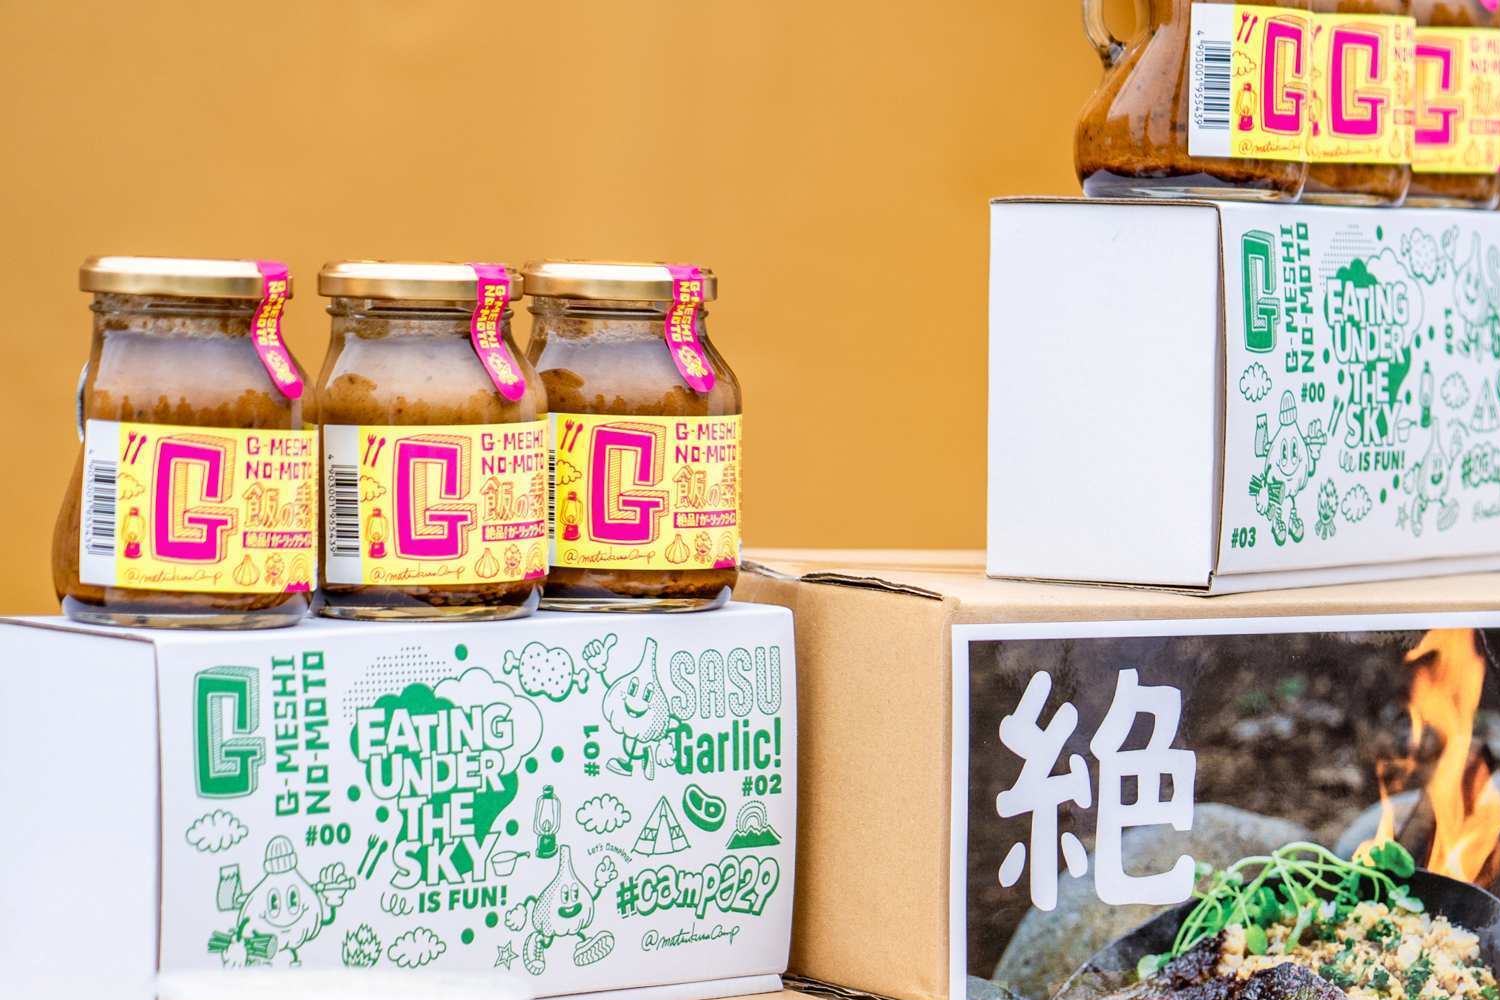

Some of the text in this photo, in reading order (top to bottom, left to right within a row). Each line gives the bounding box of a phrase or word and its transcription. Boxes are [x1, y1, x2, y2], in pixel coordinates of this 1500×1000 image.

[1327, 22, 1391, 139] G
[1241, 229, 1281, 353] G
[1279, 224, 1299, 373] G-MESHI
[1295, 221, 1315, 373] NO-MOTO
[1325, 275, 1408, 327] EATING
[1332, 320, 1406, 365] UNDER
[1300, 382, 1325, 403] #00
[1350, 361, 1392, 404] THE
[481, 429, 543, 451] G-MESHI
[675, 421, 736, 441] G-MESHI
[1344, 401, 1402, 449] SKY
[481, 453, 544, 475] NO-MOTO
[675, 444, 736, 464] NO-MOTO
[1358, 450, 1405, 471] IS FUN!
[151, 433, 238, 565] G
[392, 433, 477, 562] G
[588, 420, 669, 545] G
[1231, 527, 1257, 548] #03
[670, 645, 782, 720] SASU
[194, 665, 266, 799] G
[271, 655, 300, 816] G-MESHI
[302, 651, 331, 816] NO-MOTO
[356, 702, 514, 761] EATING
[583, 724, 601, 777] #01
[673, 716, 782, 776] Garlic!
[368, 750, 507, 800] UNDER
[741, 774, 782, 797] #02
[305, 823, 351, 847] #00
[397, 791, 476, 846] THE
[390, 830, 502, 889] SKY
[418, 884, 508, 913] IS FUN!
